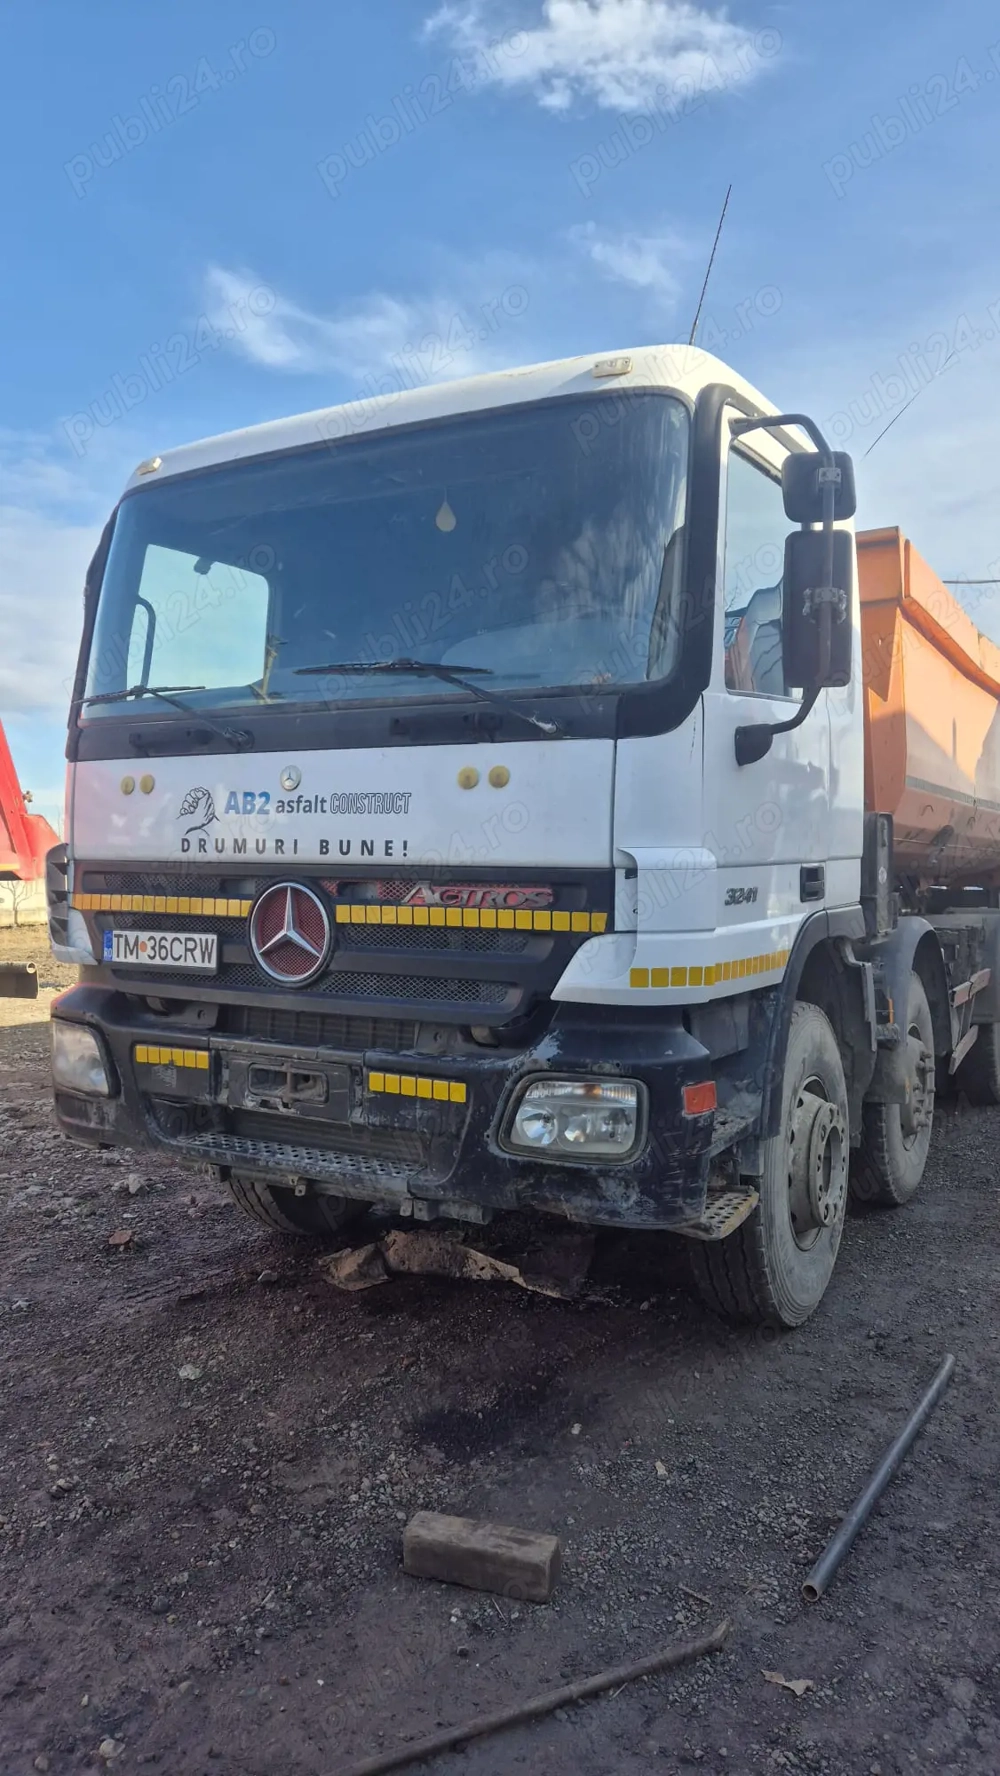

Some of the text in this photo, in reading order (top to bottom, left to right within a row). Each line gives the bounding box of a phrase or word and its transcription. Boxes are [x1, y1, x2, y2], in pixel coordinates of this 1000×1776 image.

[224, 791, 412, 815] AB2 asfalt CONSTRUCT
[180, 837, 409, 857] DRUMURI BUNE!
[724, 886, 759, 906] 3241
[113, 933, 140, 960] TM
[146, 935, 215, 964] 36CRW
